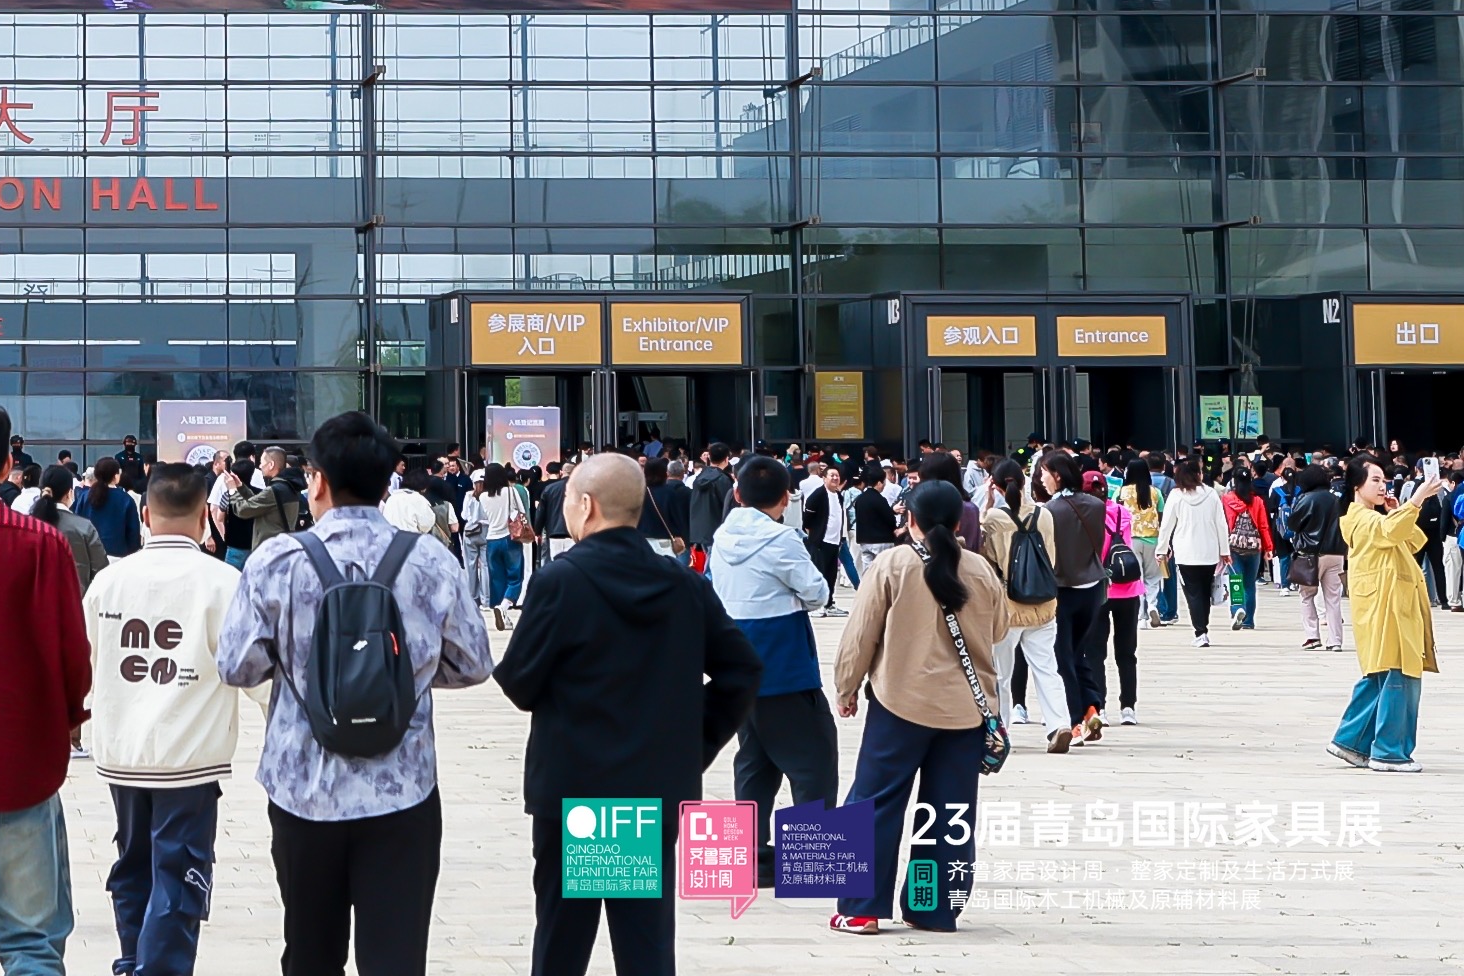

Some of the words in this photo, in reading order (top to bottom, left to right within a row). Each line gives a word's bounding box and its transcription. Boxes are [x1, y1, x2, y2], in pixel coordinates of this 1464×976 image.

[92, 176, 219, 211] HALL
[1322, 298, 1341, 324] N2
[487, 313, 586, 335] 参展商/VIP
[622, 316, 730, 335] Exhibitor/VIP
[1396, 321, 1439, 345] 出口
[639, 336, 713, 352] Entrance
[942, 325, 1020, 346] 参观入口
[1073, 328, 1150, 344] Entrance
[517, 337, 556, 357] 入口
